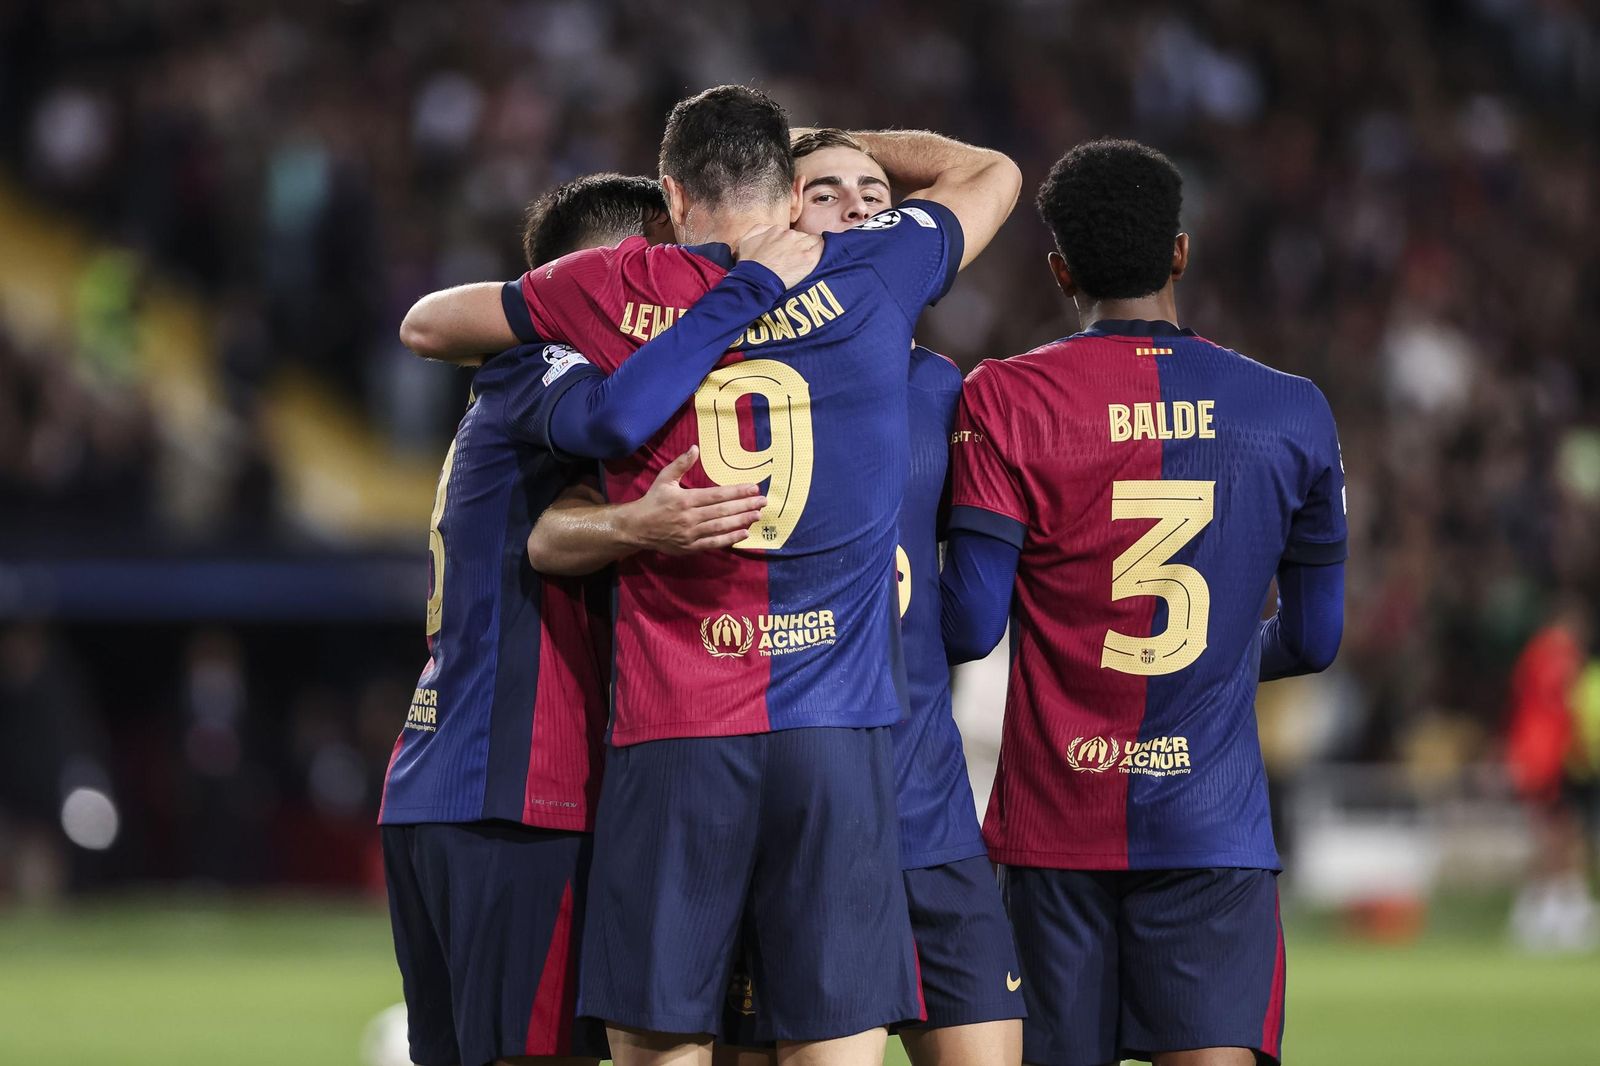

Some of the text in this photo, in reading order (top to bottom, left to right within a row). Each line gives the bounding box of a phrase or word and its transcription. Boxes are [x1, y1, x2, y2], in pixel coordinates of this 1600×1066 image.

[620, 280, 845, 349] LEWOWSKI
[1108, 400, 1216, 443] BALDE
[694, 359, 815, 550] 9
[1100, 480, 1217, 676] 3
[758, 610, 835, 631] UNHCR
[757, 627, 836, 649] ACNUR
[759, 649, 772, 657] The
[773, 648, 784, 656] UN
[784, 645, 811, 654] Refugee
[407, 704, 437, 724] CNUR
[1124, 736, 1188, 755] UNHCR
[1118, 752, 1190, 769] ACNUR
[1131, 767, 1143, 775] UN
[1143, 769, 1165, 777] Refugee
[1166, 768, 1191, 776] Agency
